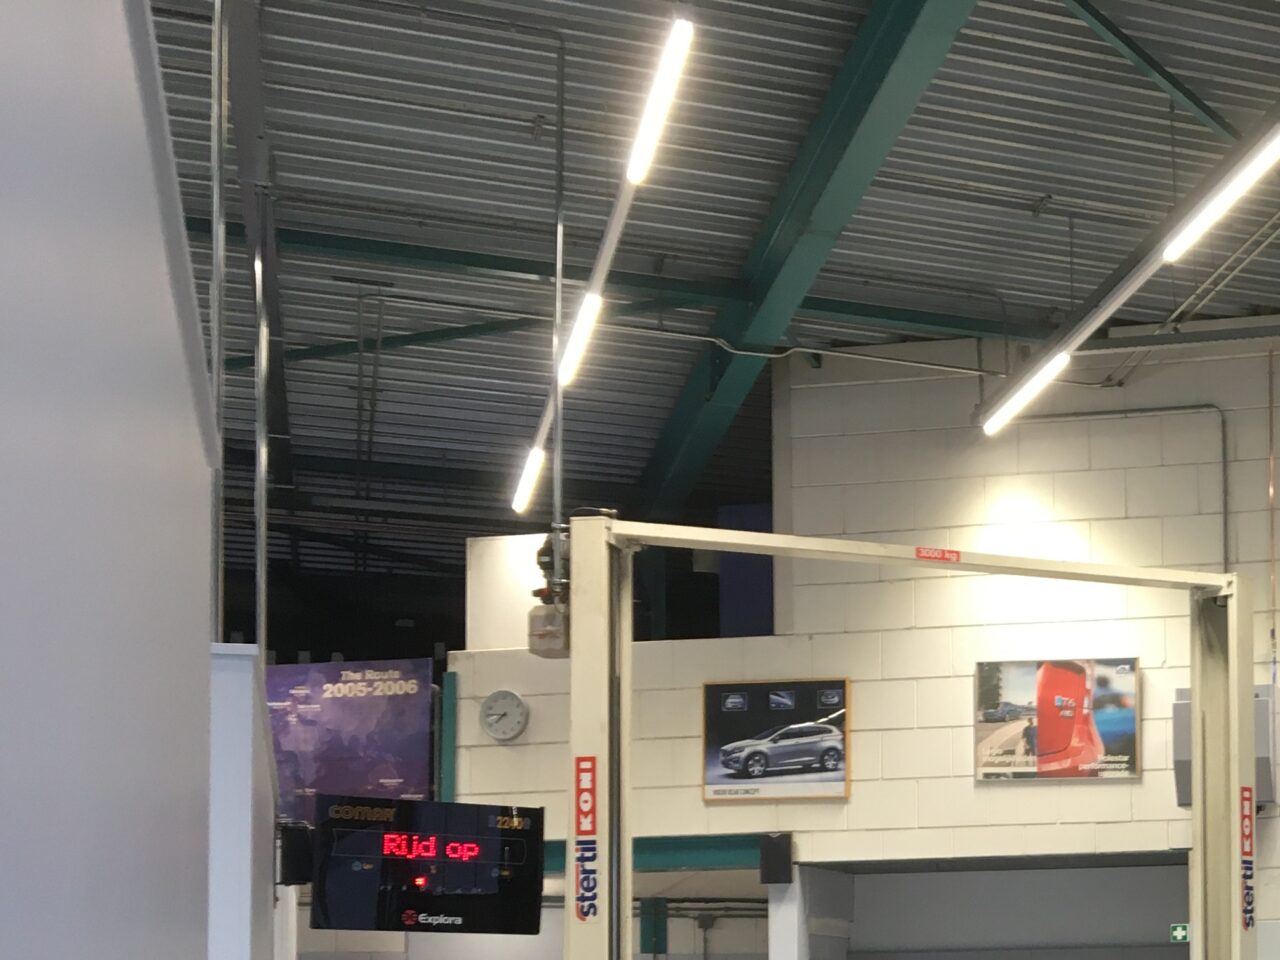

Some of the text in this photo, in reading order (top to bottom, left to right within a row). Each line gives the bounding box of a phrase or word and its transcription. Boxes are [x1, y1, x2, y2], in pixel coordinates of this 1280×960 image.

[340, 669, 401, 681] The Route
[322, 680, 418, 698] 2005-2006
[383, 833, 480, 861] Rijd op
[575, 760, 597, 920] stertil KONI
[1241, 790, 1254, 930] stertil KONI
[418, 912, 463, 926] Explora
